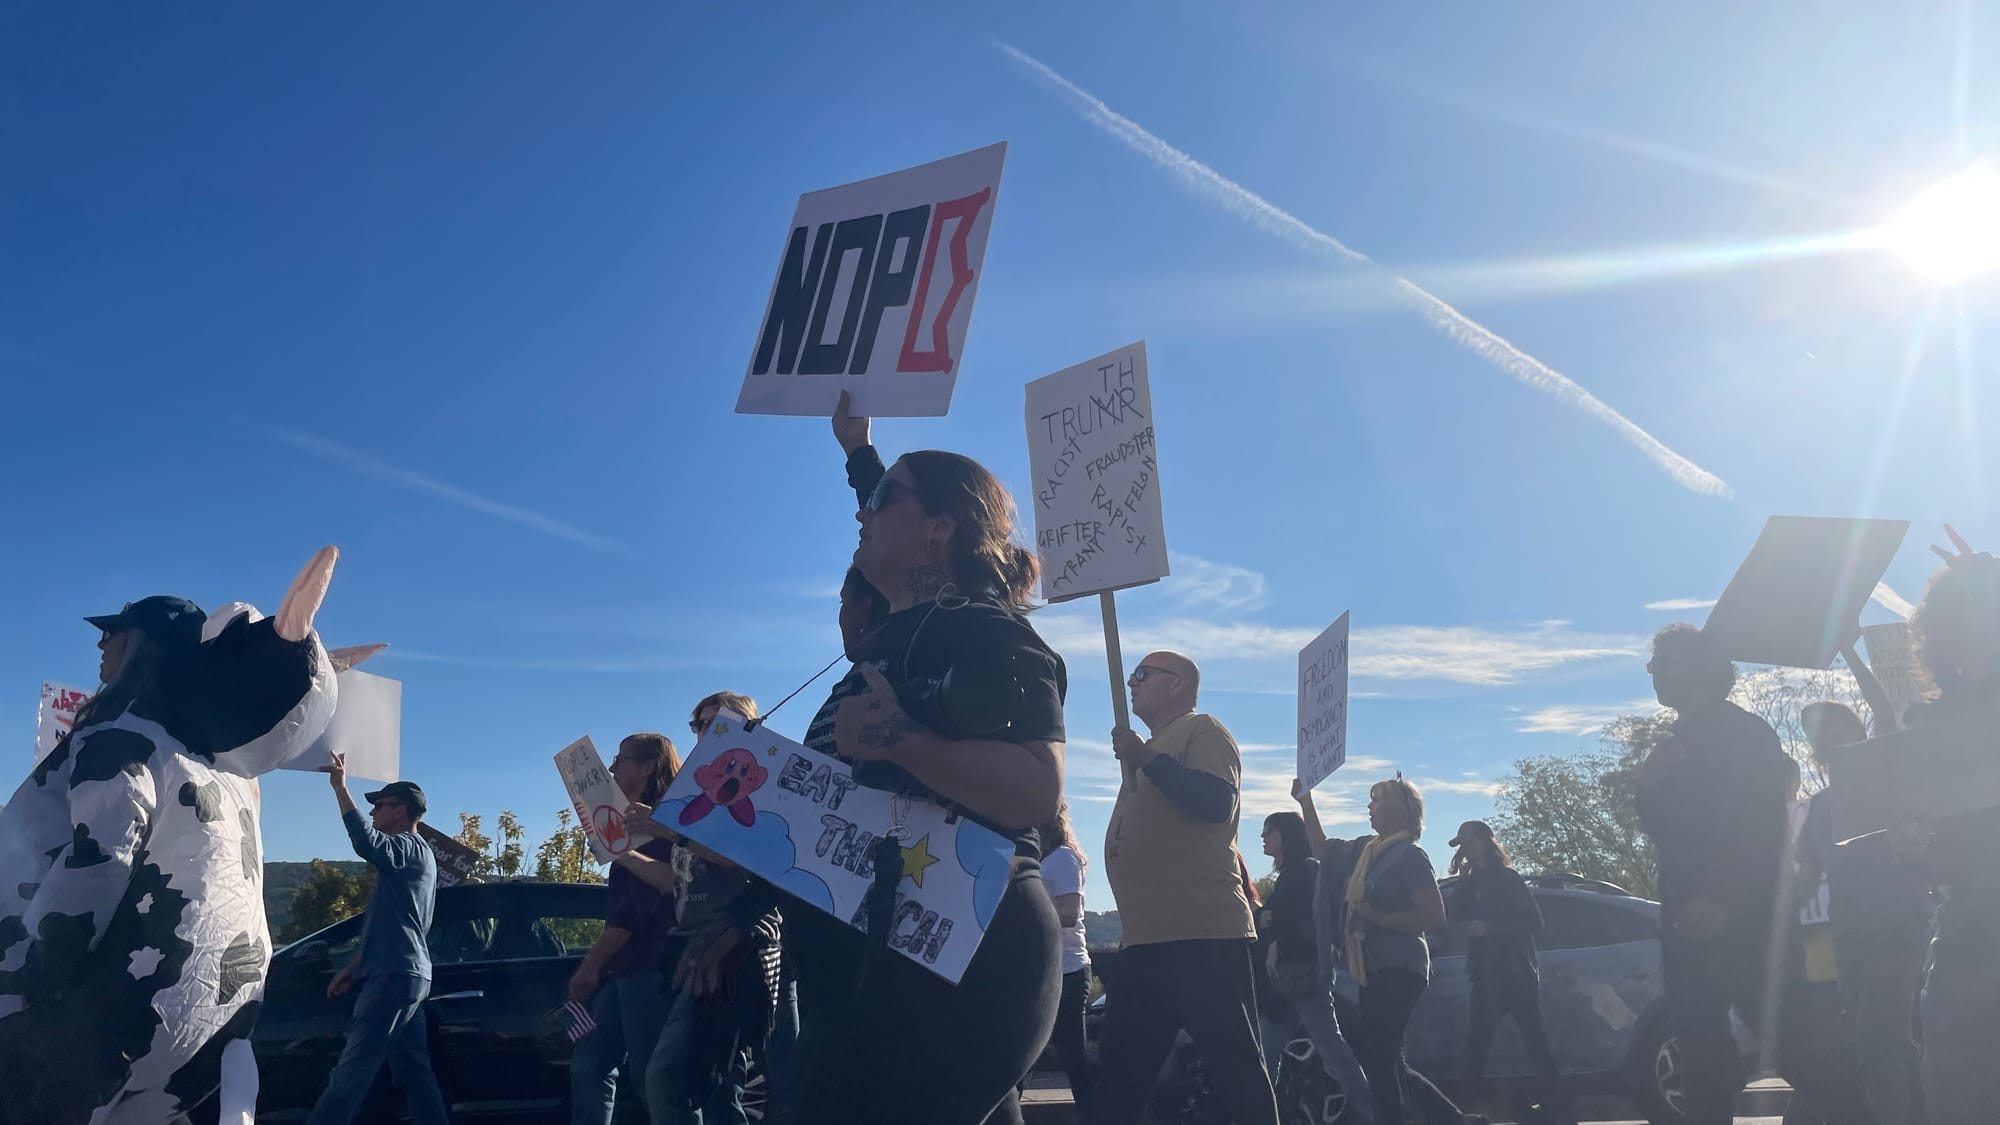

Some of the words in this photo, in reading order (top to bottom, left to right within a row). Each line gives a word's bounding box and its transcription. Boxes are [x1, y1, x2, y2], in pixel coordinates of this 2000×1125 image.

[1039, 436, 1082, 509] RACIST
[1086, 426, 1155, 480] FRAUDSTER
[1124, 455, 1155, 512] FELON
[1039, 520, 1106, 549] GRIFTER
[1091, 484, 1146, 554] RAPIST
[1052, 536, 1105, 591] TYRANT
[1303, 637, 1347, 698] FREEDOM
[1317, 683, 1334, 708] AND
[1301, 702, 1344, 749] DEMOCRACY
[1319, 726, 1341, 755] WHAT
[777, 753, 857, 810] EAT
[1323, 744, 1344, 773] WANT
